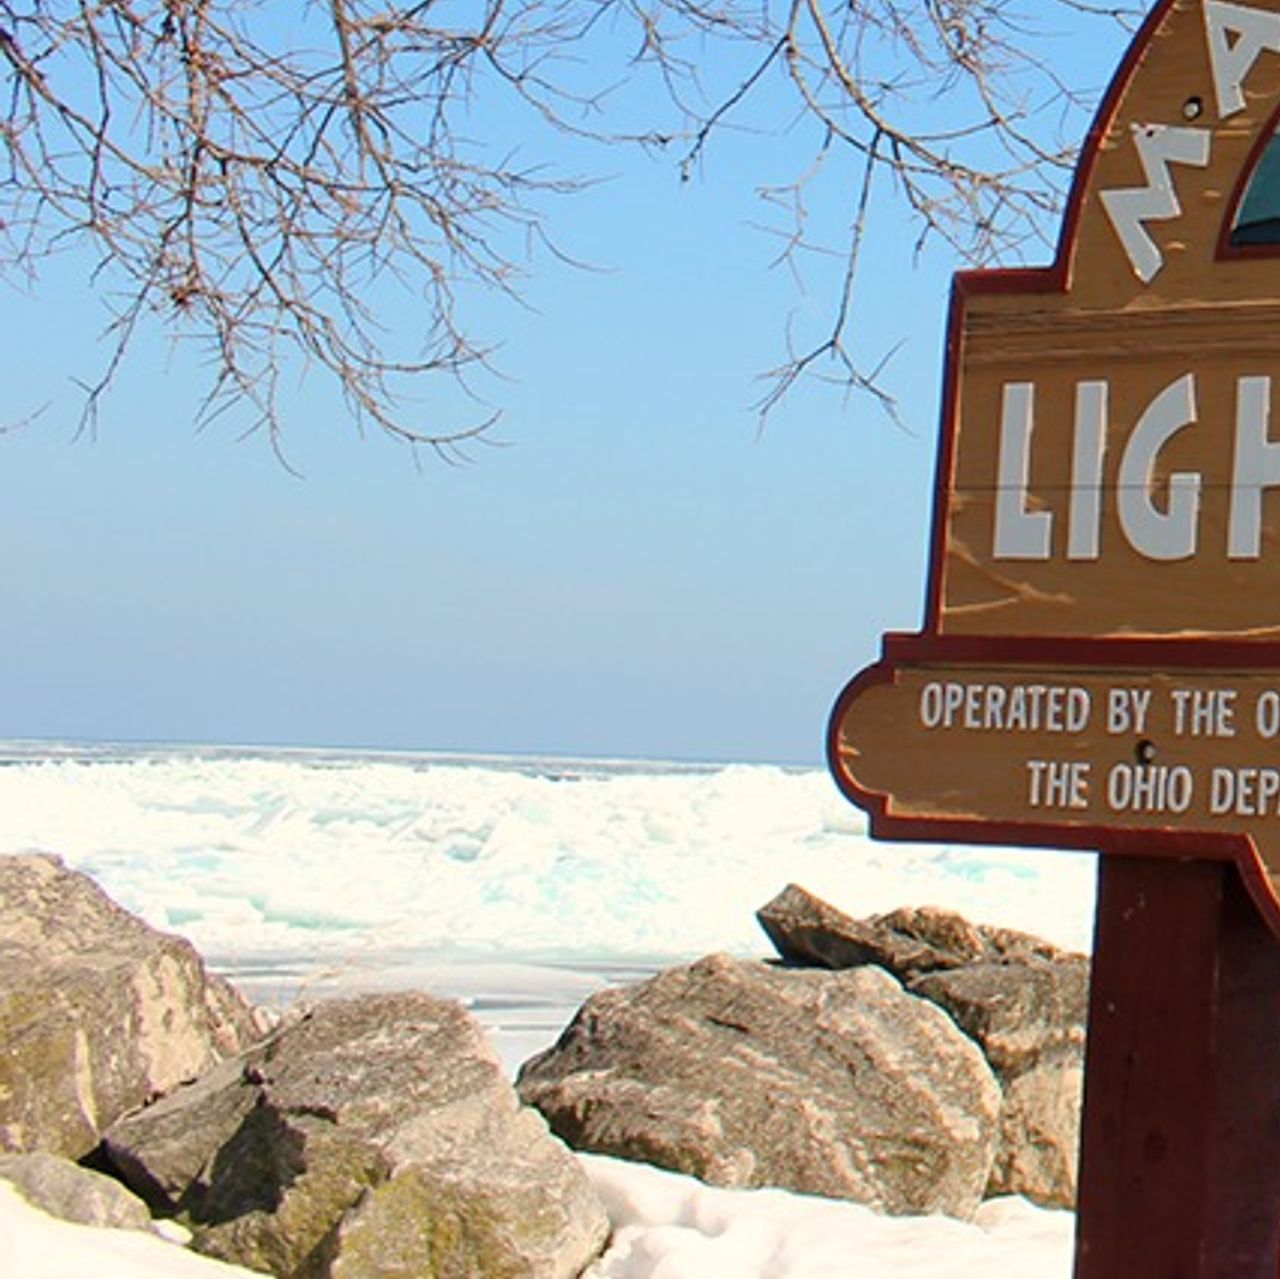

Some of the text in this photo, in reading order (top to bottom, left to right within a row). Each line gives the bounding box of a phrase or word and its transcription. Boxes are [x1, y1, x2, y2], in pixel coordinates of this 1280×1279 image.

[921, 682, 1091, 732] OPERATED
[1108, 688, 1152, 734] BY
[1171, 689, 1238, 737] THE
[1026, 760, 1091, 808] THE
[1108, 763, 1193, 813] OHIO
